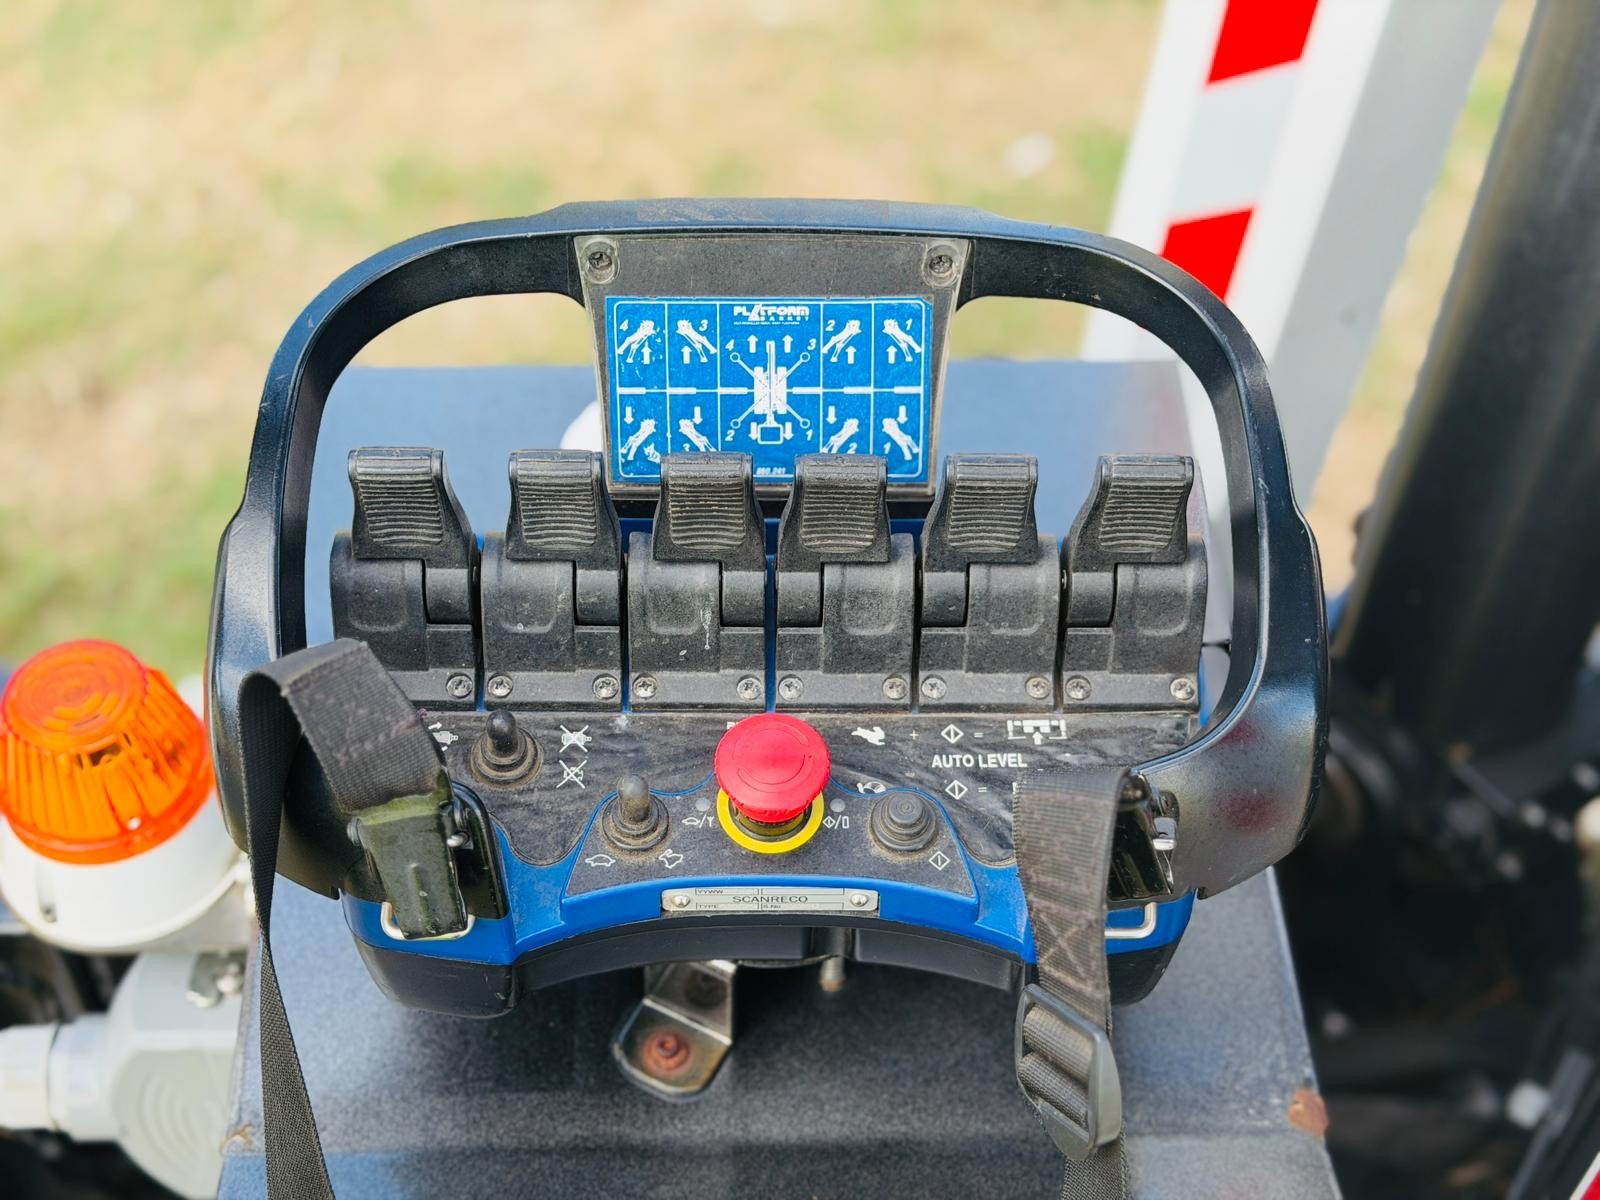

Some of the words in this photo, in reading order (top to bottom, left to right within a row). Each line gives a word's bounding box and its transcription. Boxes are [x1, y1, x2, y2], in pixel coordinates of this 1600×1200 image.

[733, 304, 810, 320] PLATFORM
[619, 319, 629, 331] 4
[699, 319, 708, 331] 3
[825, 319, 835, 331] 2
[905, 319, 913, 330] 1
[725, 339, 735, 351] 4
[807, 338, 817, 350] 3
[725, 429, 735, 441] 2
[805, 429, 813, 441] 1
[847, 442, 858, 454] 2
[883, 441, 892, 454] 1
[932, 755, 974, 768] AUTO
[978, 753, 1027, 768] LEVEL
